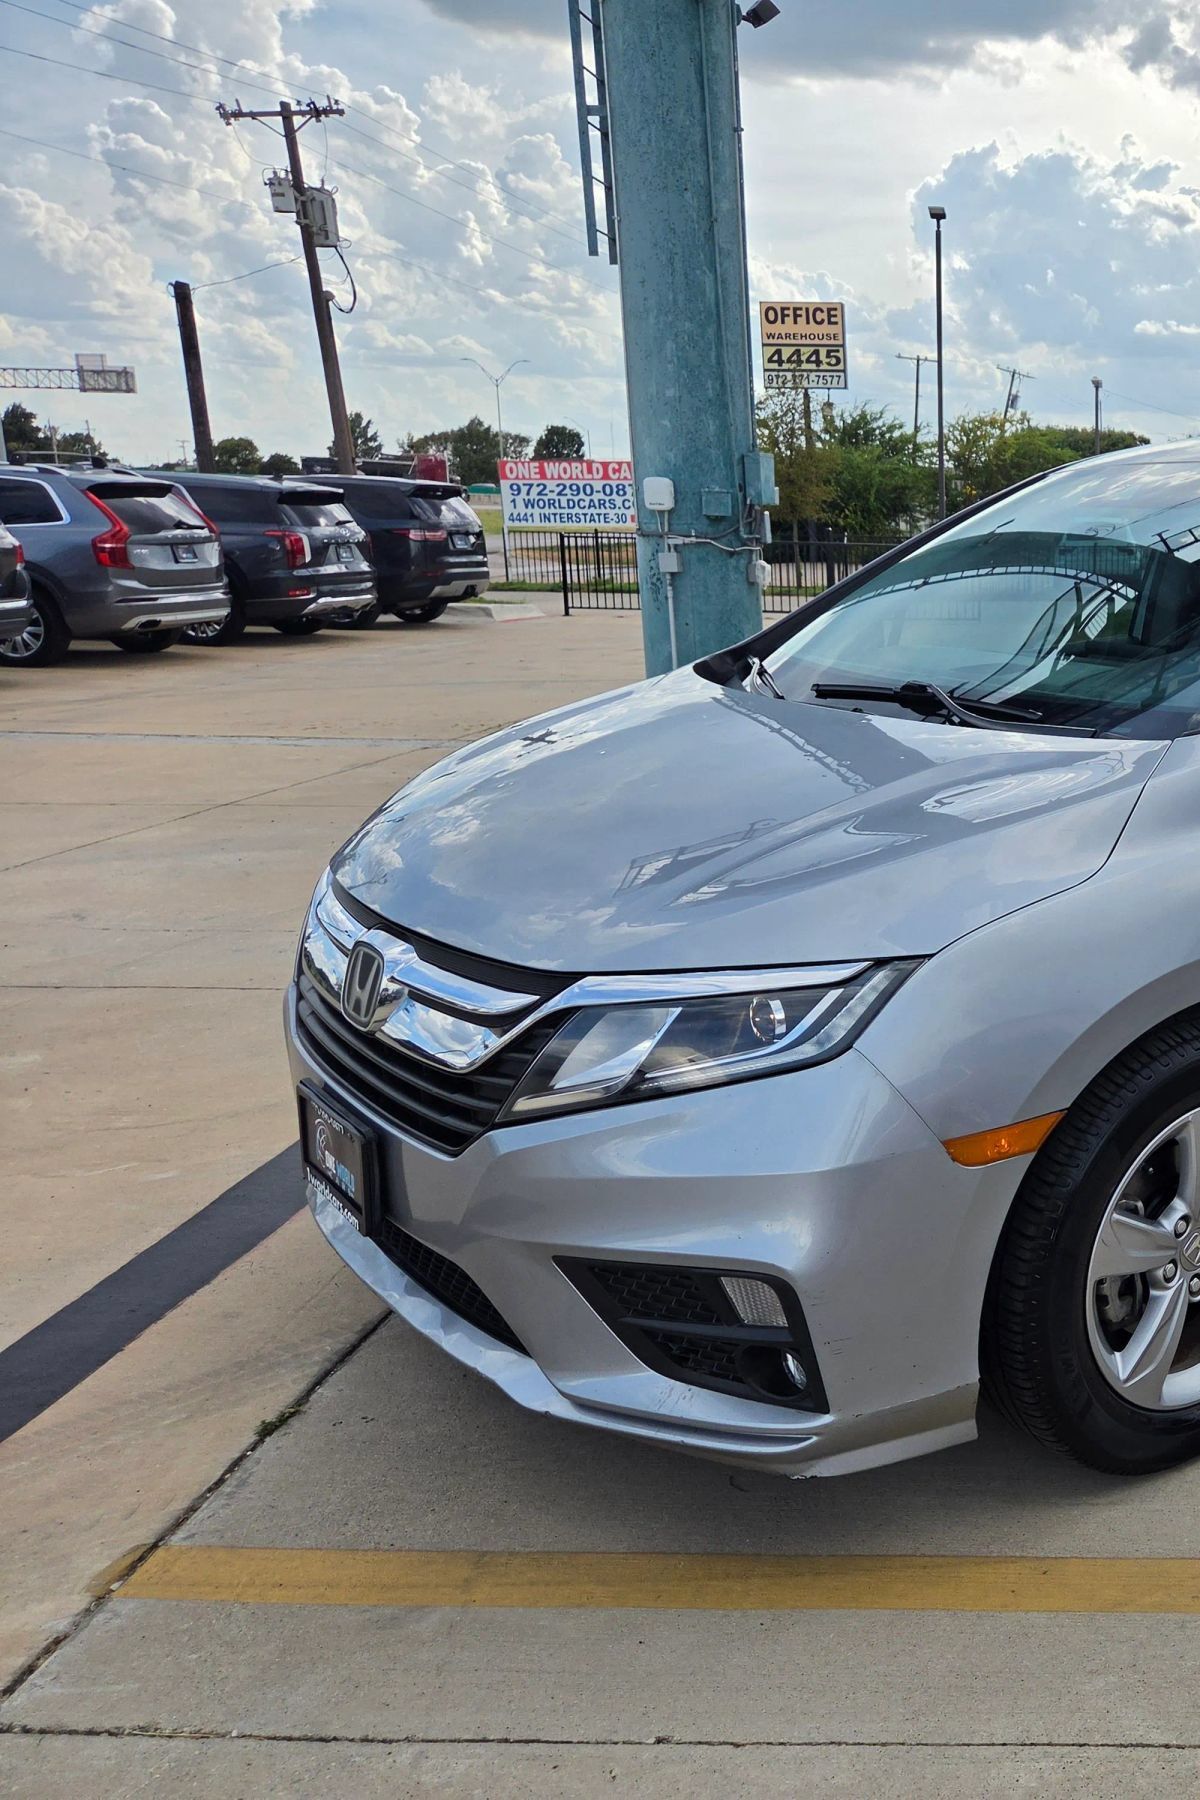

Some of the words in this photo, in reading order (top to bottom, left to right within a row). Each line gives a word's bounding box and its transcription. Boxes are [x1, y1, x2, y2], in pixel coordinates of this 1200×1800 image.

[764, 306, 839, 325] OFFICE
[766, 332, 840, 341] WAREHOUSE
[767, 348, 842, 368] 4445
[505, 462, 541, 479] ONE
[544, 462, 603, 479] WORLD
[510, 499, 517, 510] 1
[522, 498, 636, 510] WORLDCARS.C
[508, 512, 535, 522] 4441
[539, 512, 627, 524] INTERSTATE-30
[306, 1167, 360, 1231] 1worldcars.com
